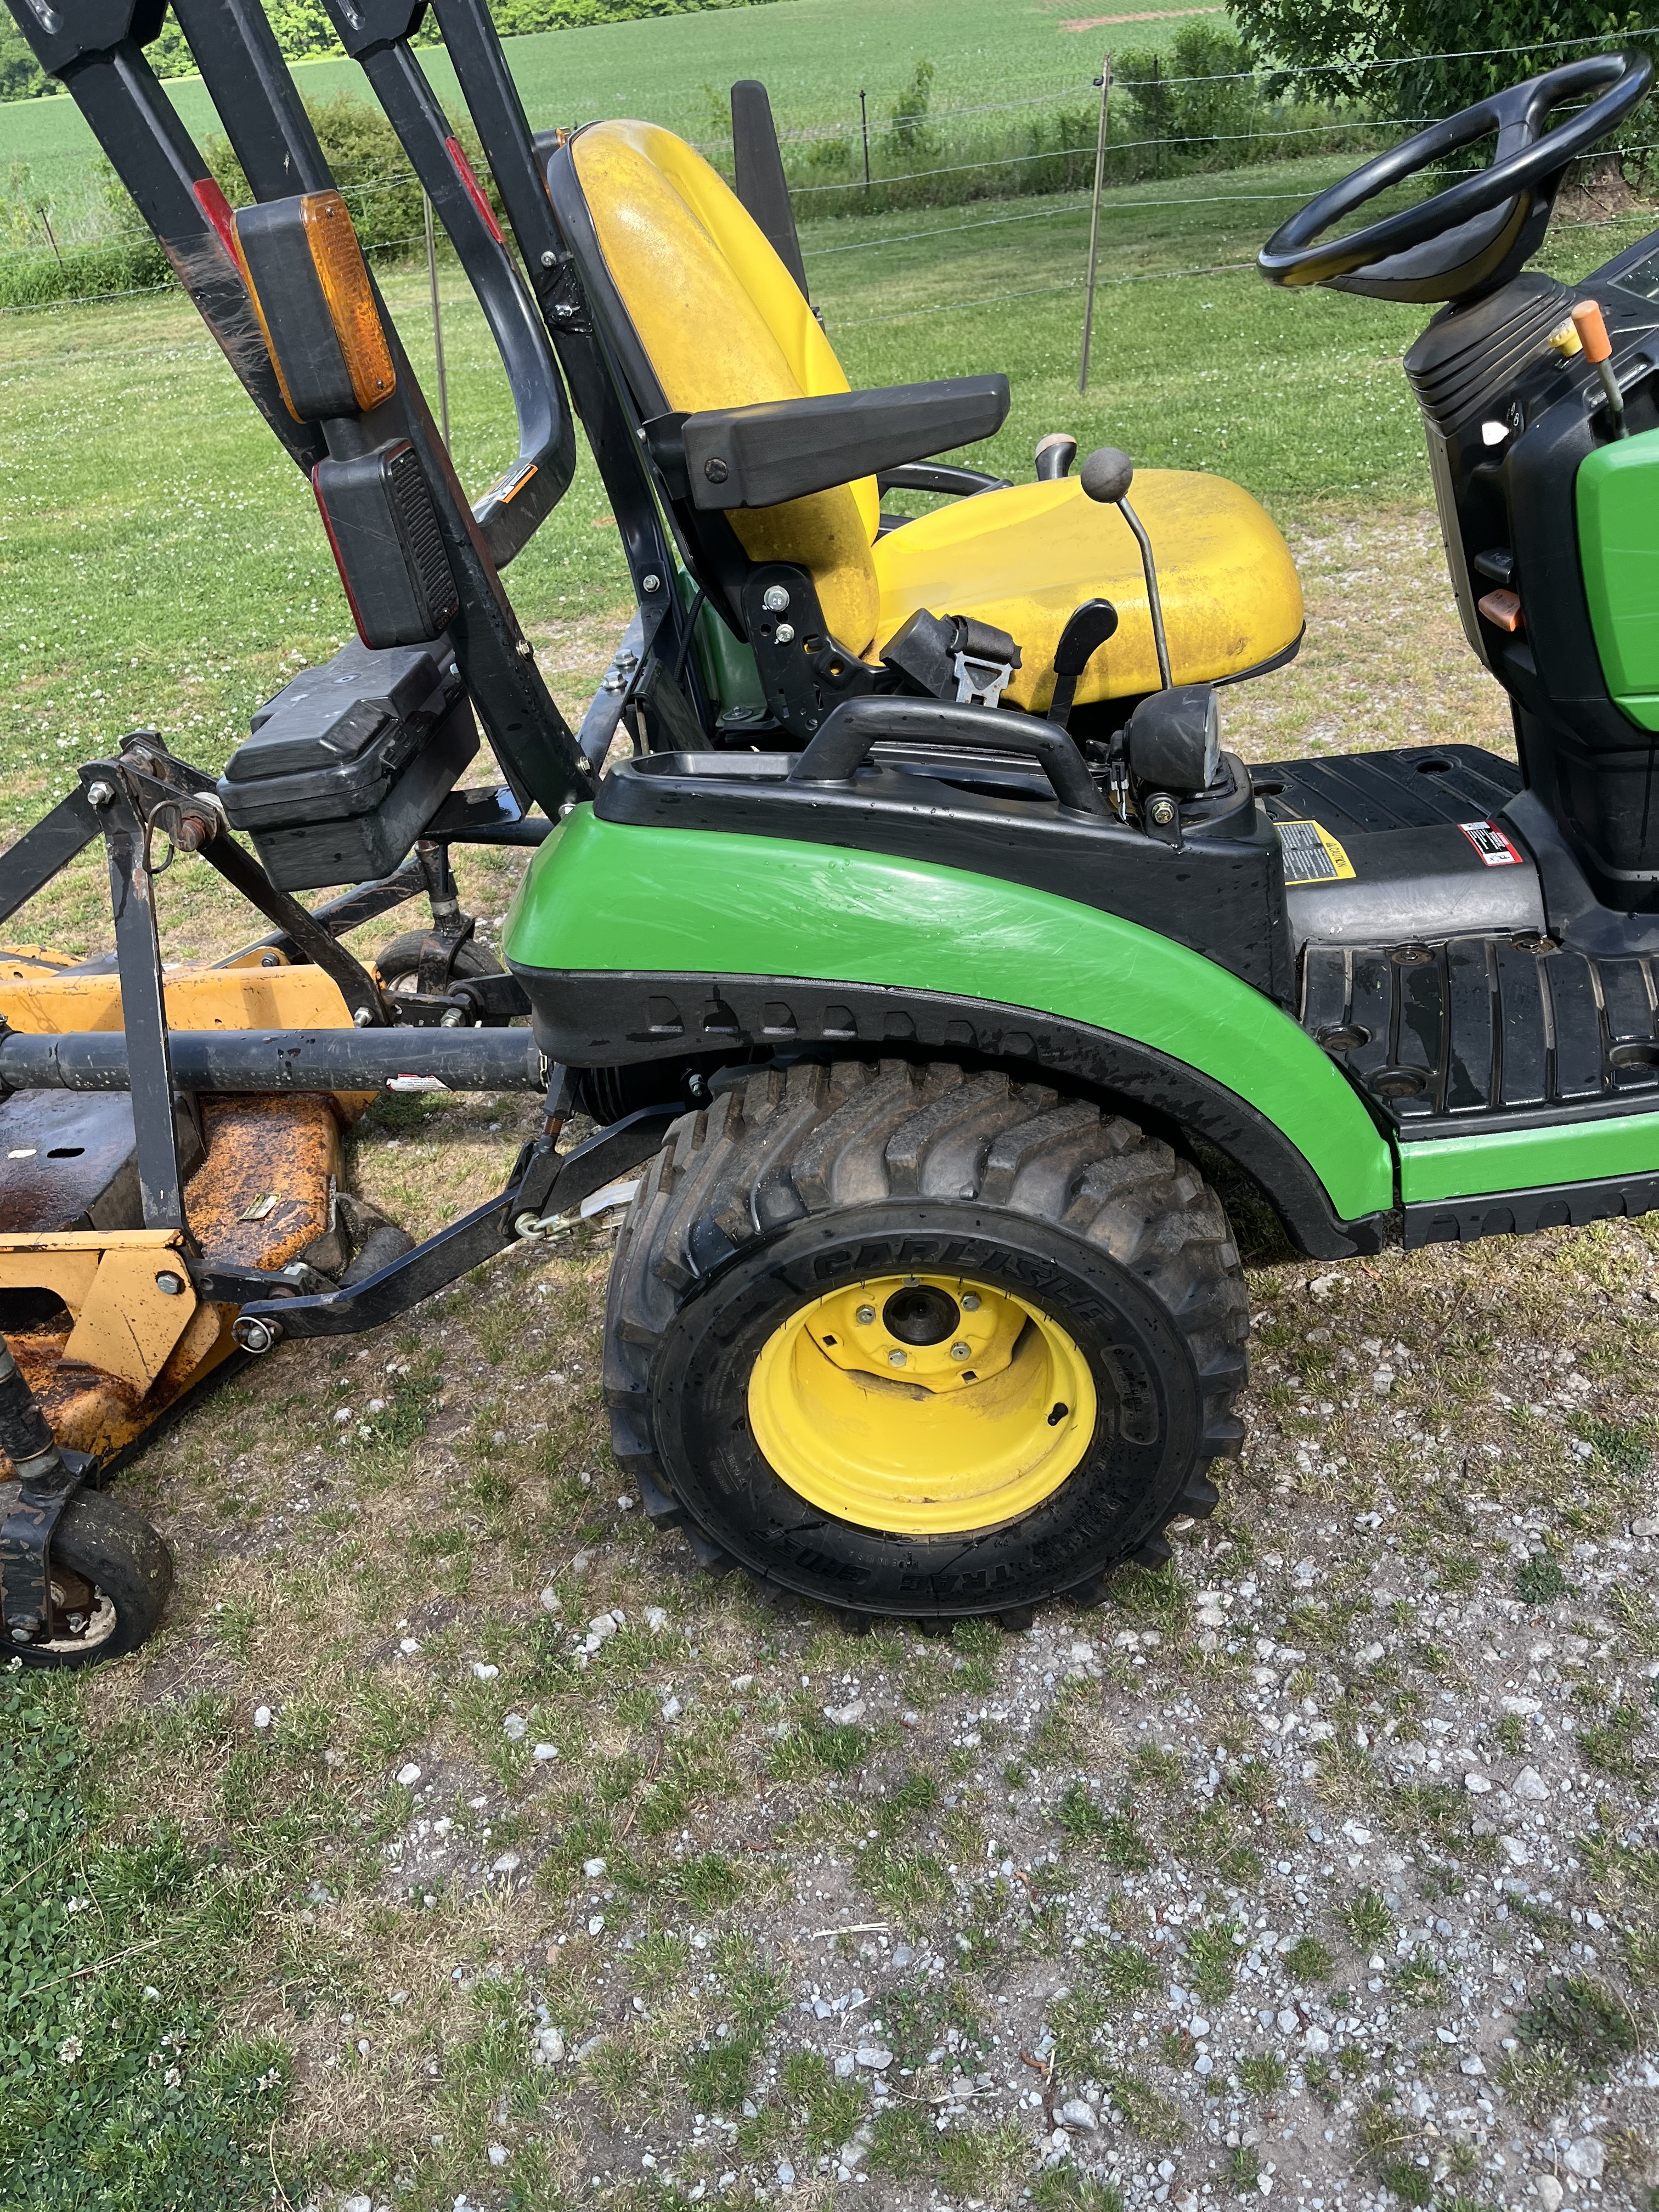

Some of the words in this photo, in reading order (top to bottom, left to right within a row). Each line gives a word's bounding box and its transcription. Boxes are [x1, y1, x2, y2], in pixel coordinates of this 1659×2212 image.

[1329, 847, 1348, 868] CAUTION
[813, 1238, 1115, 1328] CARLISLE
[749, 1528, 872, 1585] CHIEF
[878, 1556, 889, 1567] IN
[891, 1558, 919, 1571] MADE
[900, 1564, 1016, 1591] TRAC
